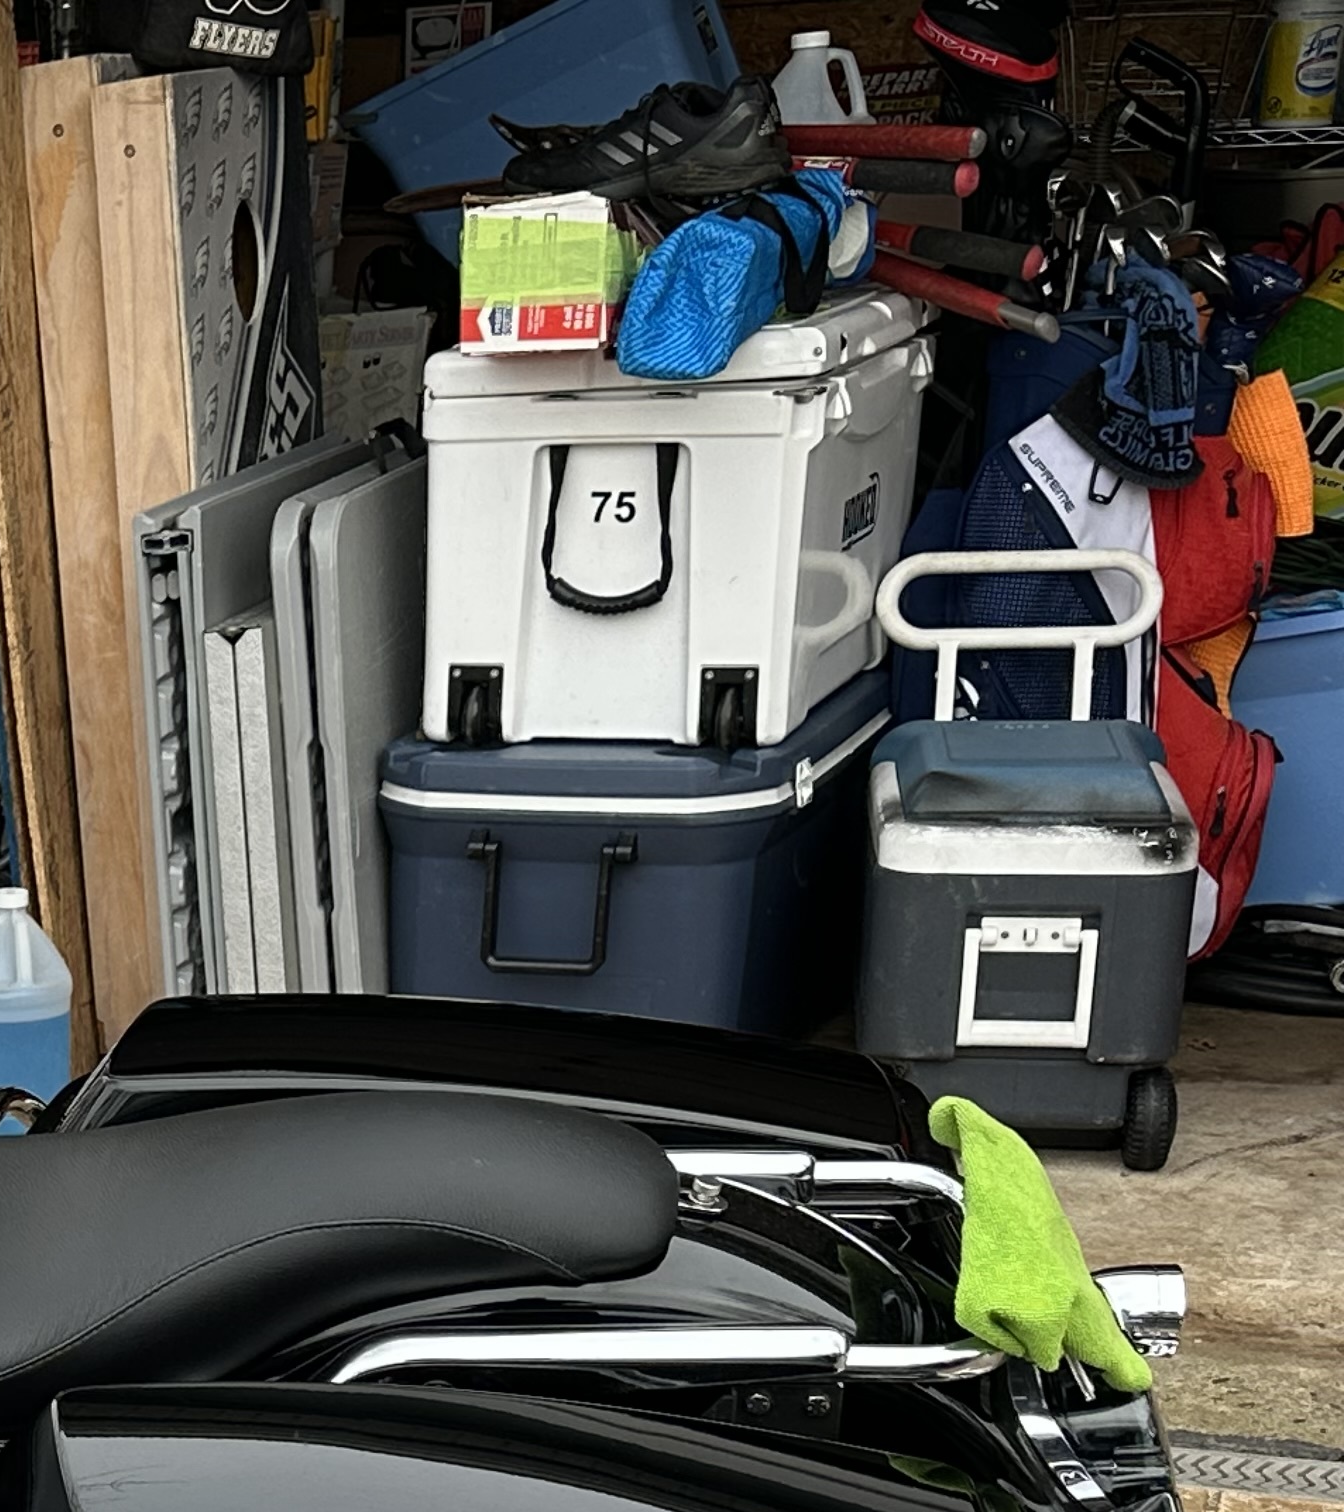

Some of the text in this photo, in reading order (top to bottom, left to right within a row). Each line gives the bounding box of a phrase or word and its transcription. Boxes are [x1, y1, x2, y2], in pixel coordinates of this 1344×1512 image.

[189, 17, 280, 58] FLYERS
[923, 21, 999, 67] STEALTH
[1019, 443, 1076, 514] SUPREME
[591, 491, 636, 523] 75
